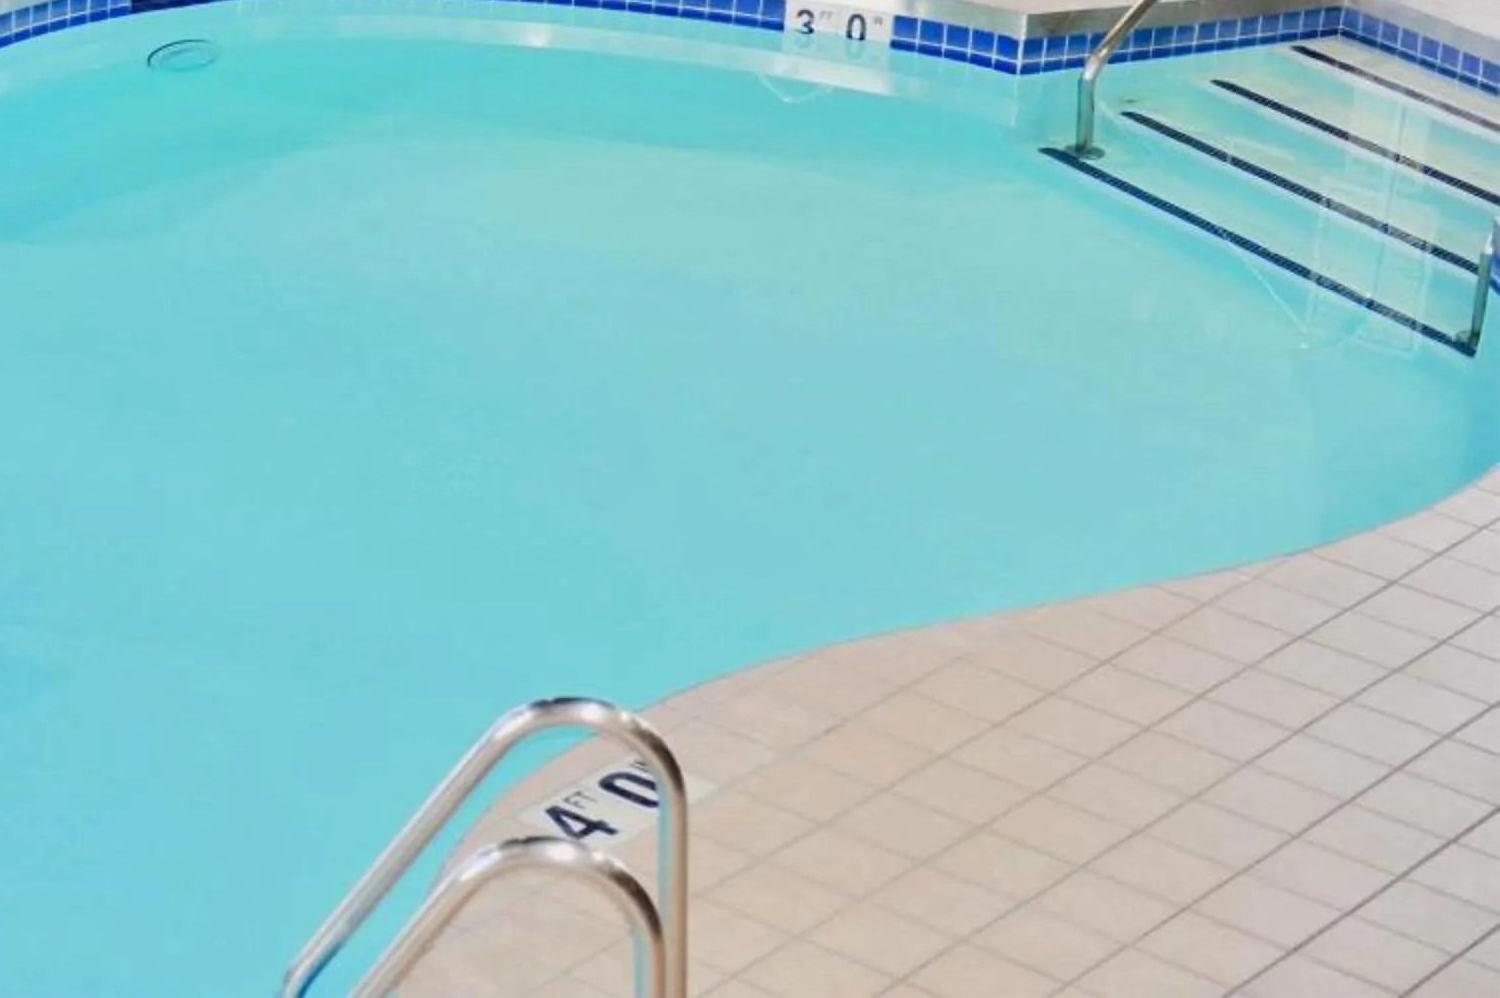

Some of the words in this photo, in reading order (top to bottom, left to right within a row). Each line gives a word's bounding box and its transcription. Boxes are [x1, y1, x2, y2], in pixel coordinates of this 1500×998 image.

[796, 9, 815, 35] 3
[845, 13, 867, 42] 0
[545, 805, 619, 840] 4
[598, 771, 661, 809] 0
